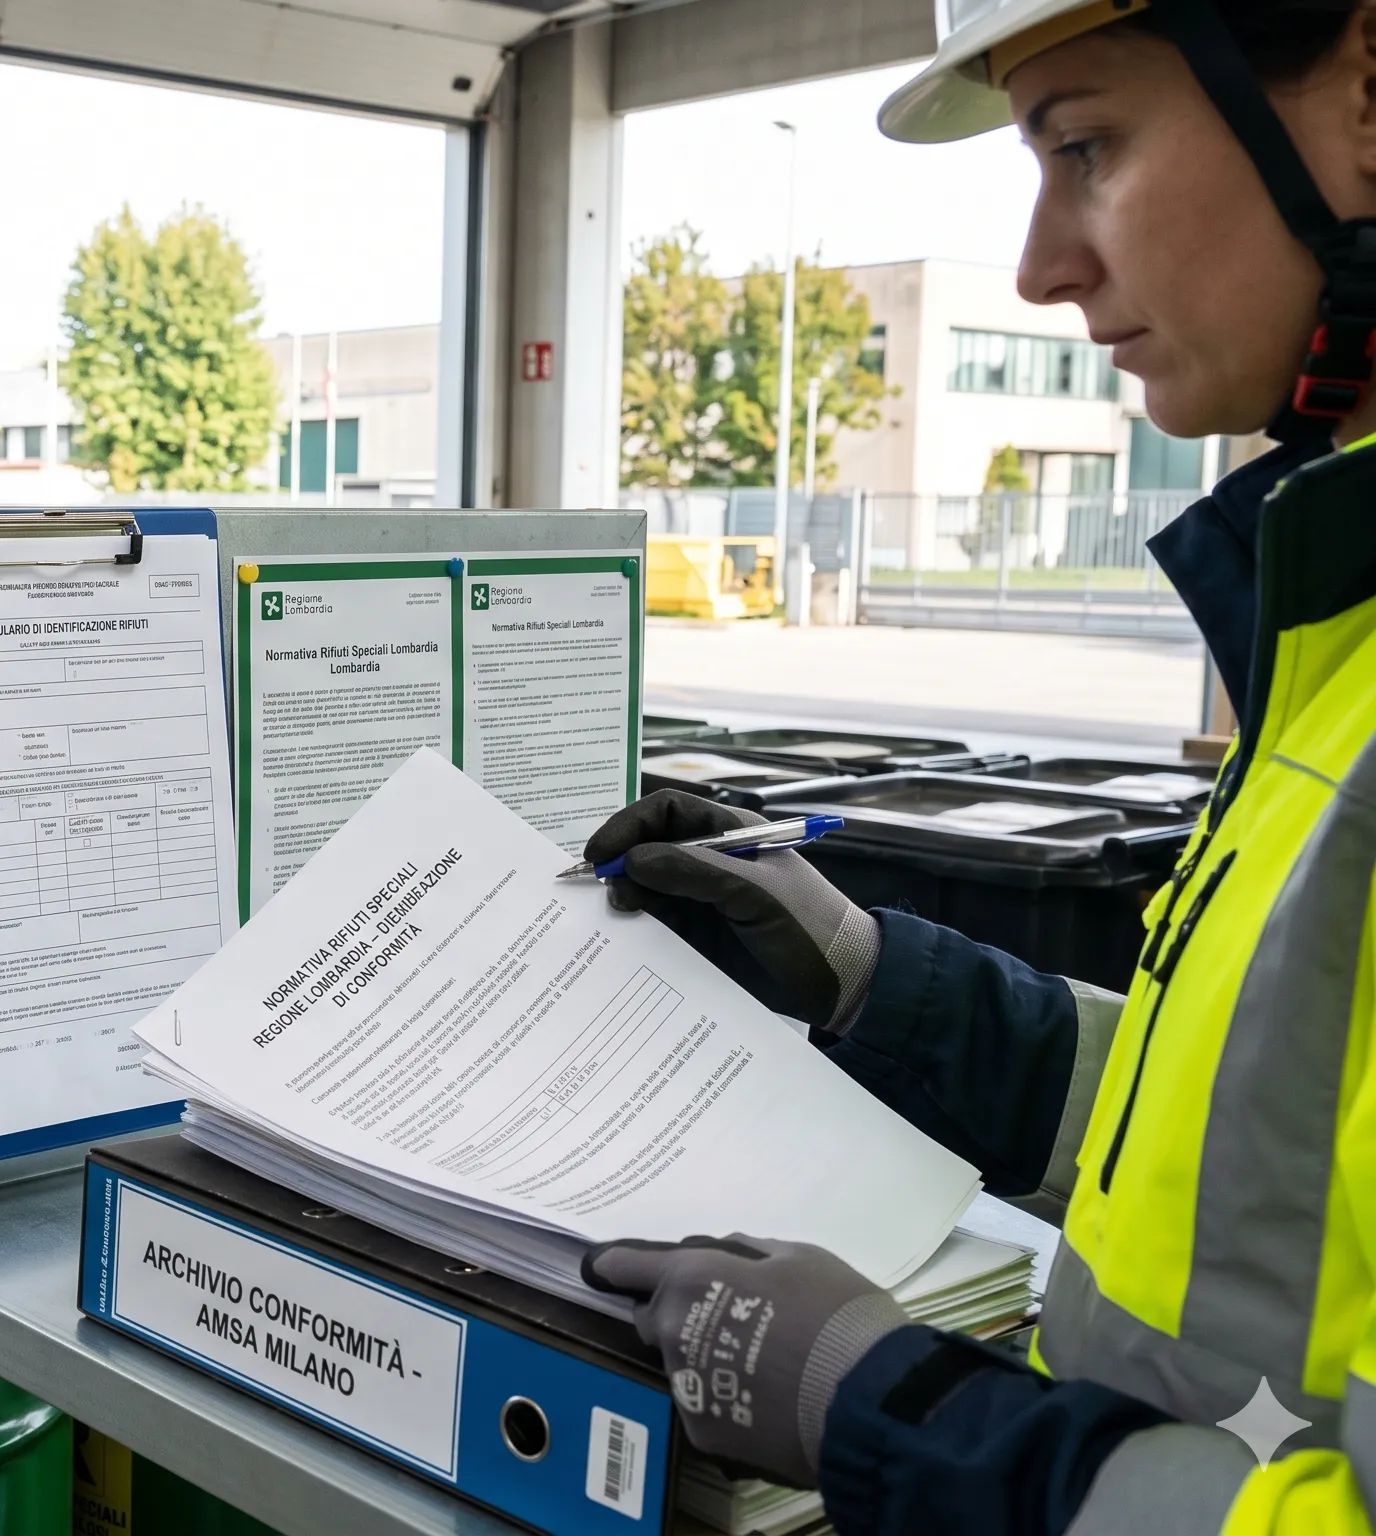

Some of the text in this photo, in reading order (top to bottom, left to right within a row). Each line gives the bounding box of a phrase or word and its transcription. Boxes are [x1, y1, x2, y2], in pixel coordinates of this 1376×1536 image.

[33, 622, 42, 634] DI
[44, 620, 117, 634] IDENTIFICAZIONE
[119, 618, 149, 631] RIFIUTI
[285, 604, 333, 615] Lombardia
[491, 618, 604, 632] Normativa Rifiuti Speciali Lombardia
[265, 640, 439, 662] Normativa Rifiuti Speciali Lombardia
[330, 660, 380, 675] Lombardia
[262, 861, 418, 1011] NORMATIVA RIFIUTI SPECIALI
[331, 922, 422, 1008] DI CONFORMITÀ
[252, 999, 308, 1048] REGIONE
[303, 940, 372, 1004] LOMBARDIA
[143, 1240, 243, 1304] ARCHIVIO
[249, 1286, 404, 1379] CONFORMITÀ
[195, 1304, 355, 1397] AMSA MILANO
